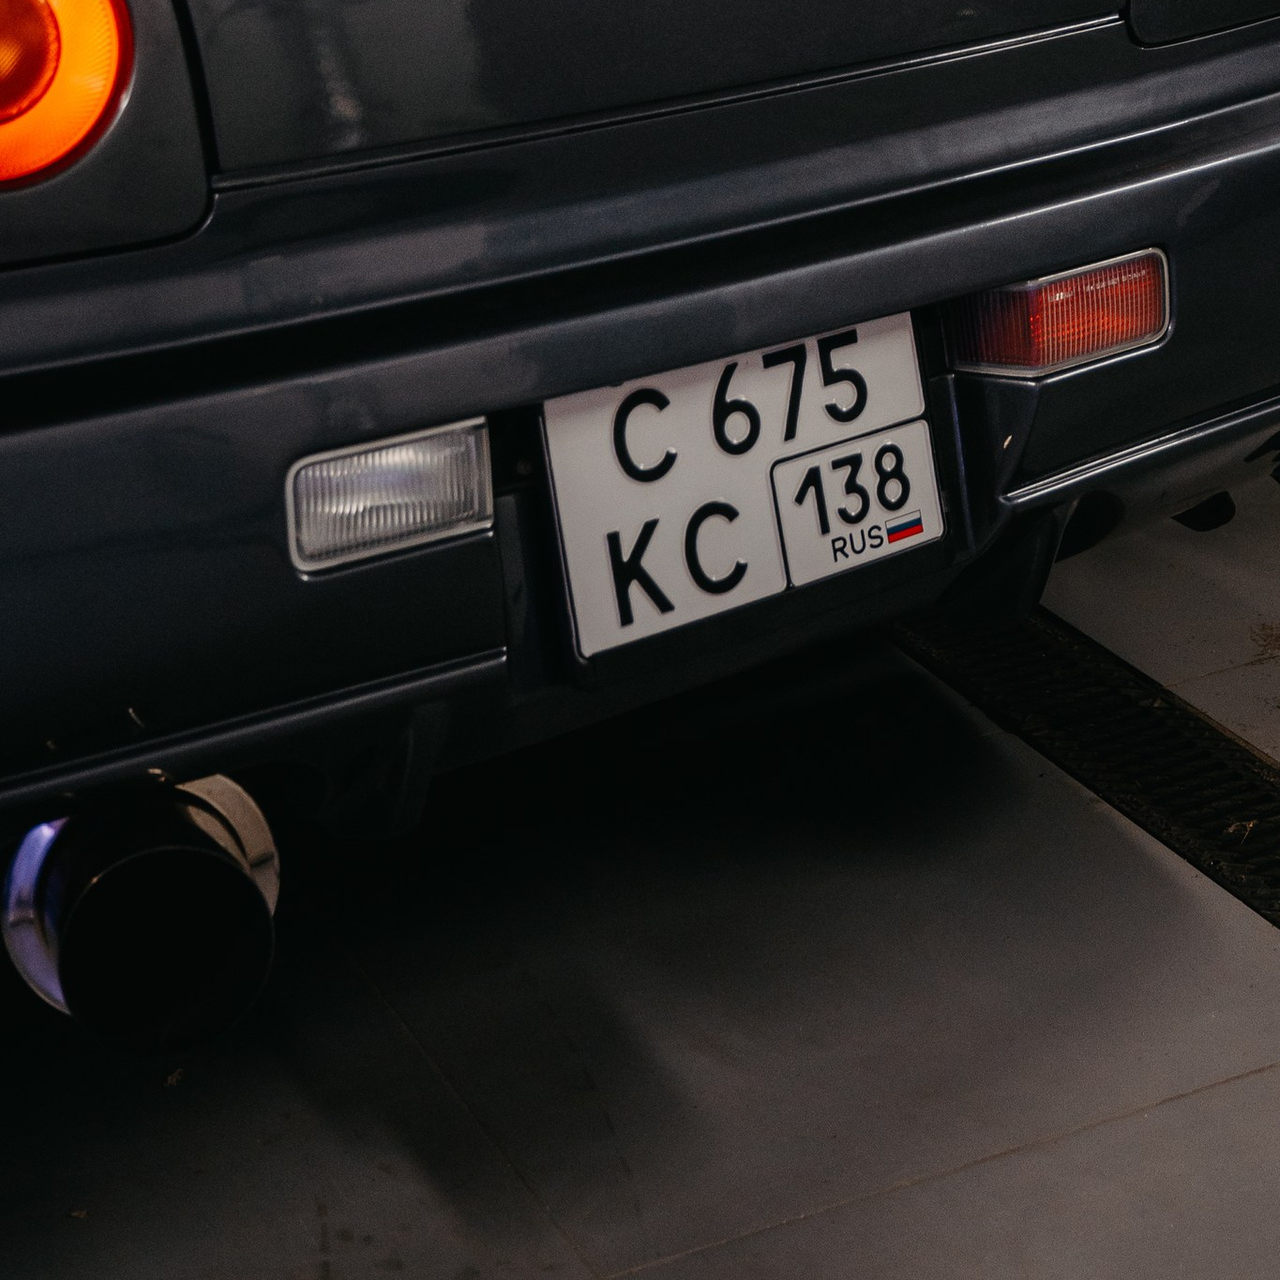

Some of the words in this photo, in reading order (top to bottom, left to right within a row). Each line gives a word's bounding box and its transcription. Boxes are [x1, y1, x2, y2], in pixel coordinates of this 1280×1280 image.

[612, 387, 679, 483] C
[711, 328, 868, 456] 675
[793, 441, 911, 536] 138
[830, 524, 886, 563] RUS
[606, 499, 749, 628] KC
